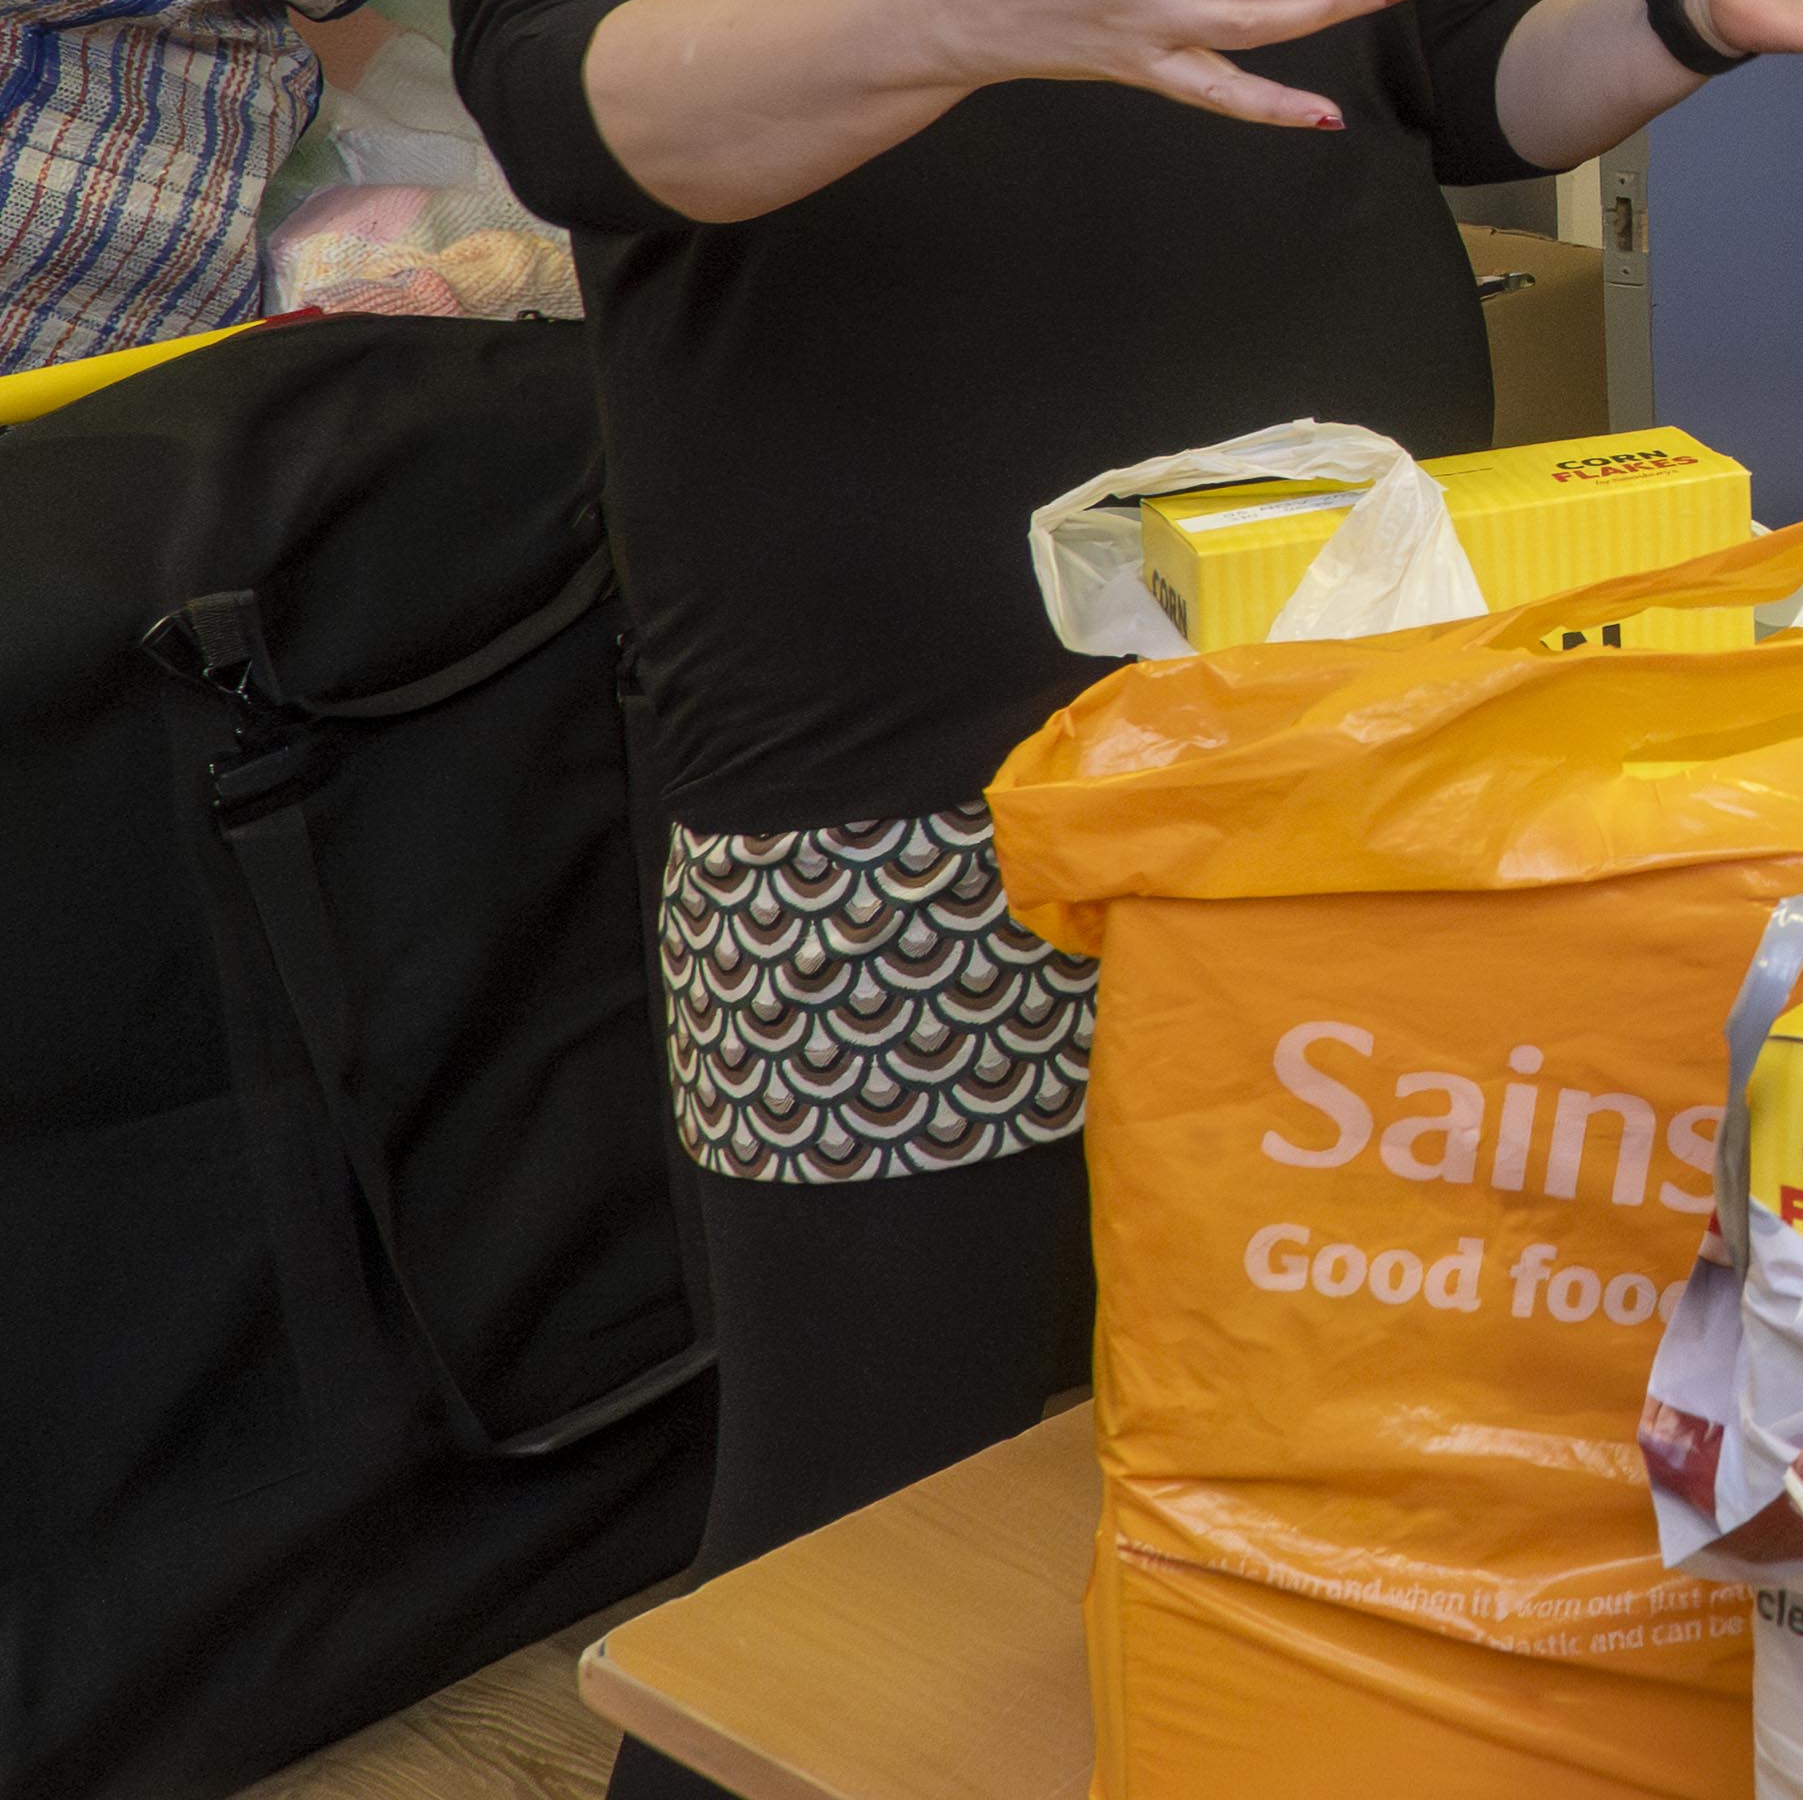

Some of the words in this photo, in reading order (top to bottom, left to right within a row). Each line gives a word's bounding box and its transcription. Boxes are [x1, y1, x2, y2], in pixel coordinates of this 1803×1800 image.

[1552, 456, 1699, 483] FLAKES
[1556, 450, 1668, 470] CORN
[1260, 1020, 1725, 1214] Sains
[1244, 1222, 1484, 1312] Good
[1587, 1591, 1634, 1614] out
[1589, 1624, 1644, 1657] and
[1652, 1619, 1701, 1646] can
[1709, 1615, 1745, 1639] be
